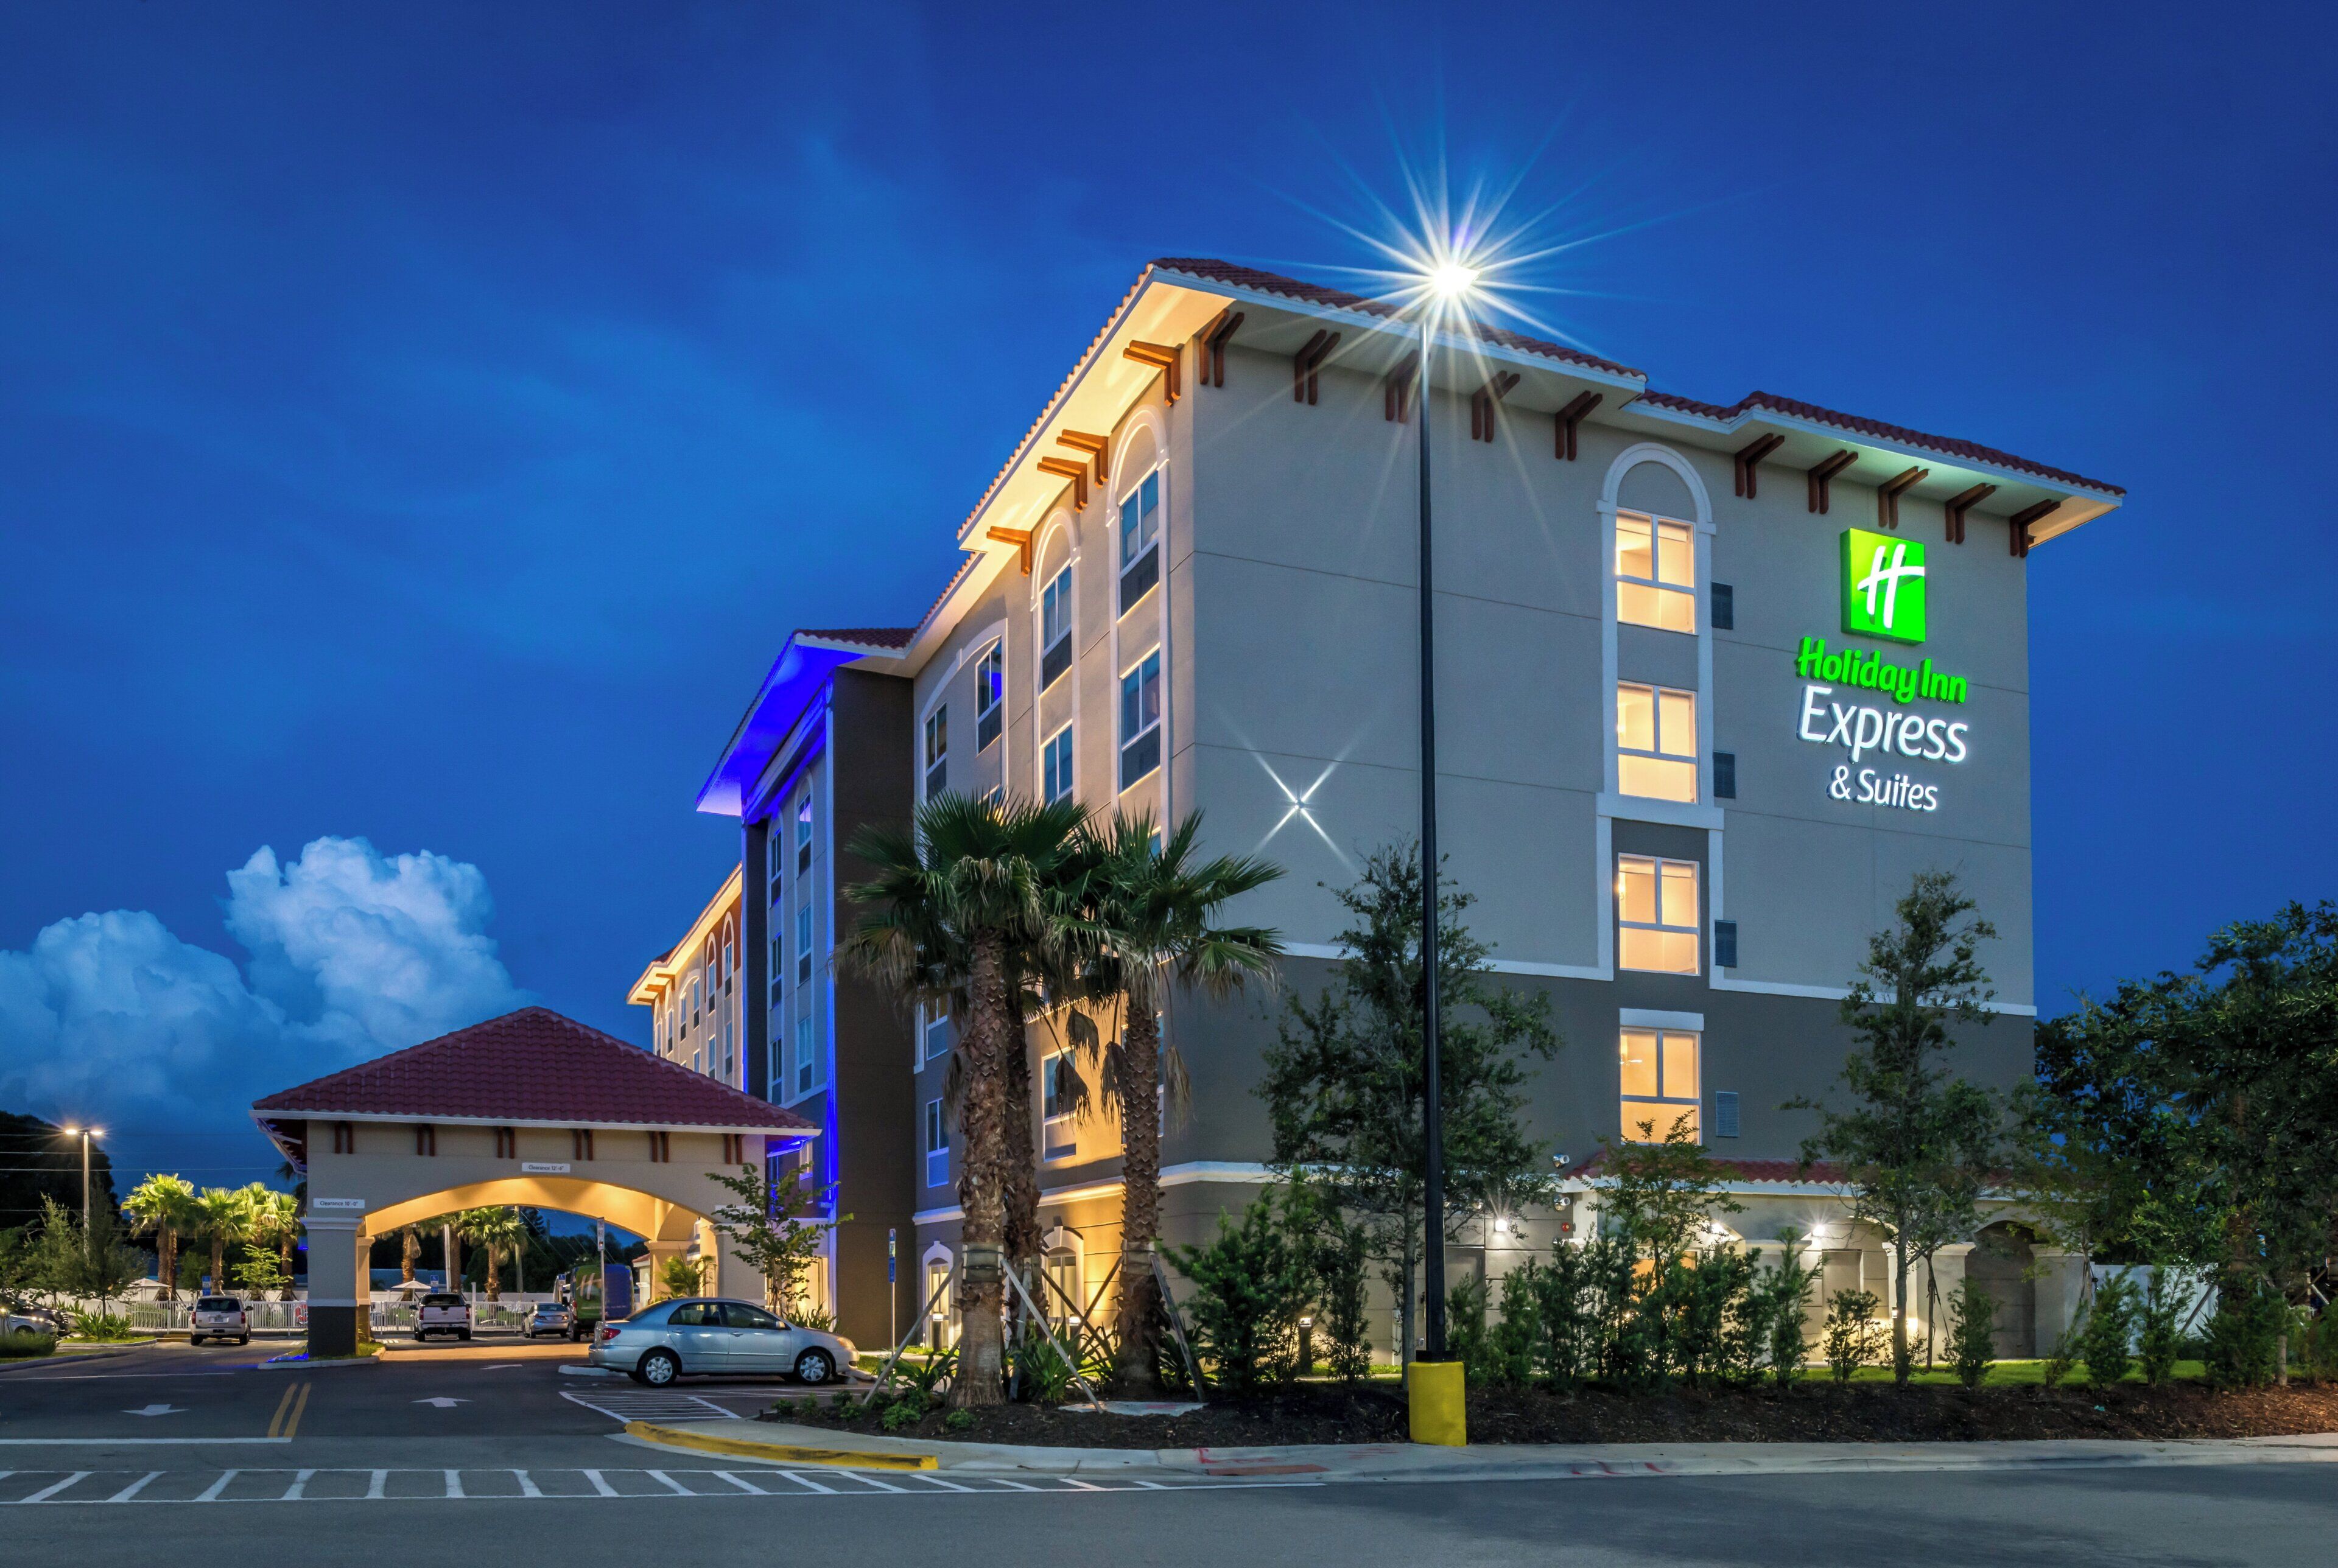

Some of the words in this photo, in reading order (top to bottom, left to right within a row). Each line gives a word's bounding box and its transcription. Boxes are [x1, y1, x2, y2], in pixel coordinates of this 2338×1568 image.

[1857, 544, 1925, 629] H
[1797, 637, 1917, 704] Holiday
[1920, 659, 1967, 704] Inn
[1798, 684, 1968, 763] Express
[1828, 765, 1851, 800] &
[1856, 769, 1938, 811] Suites
